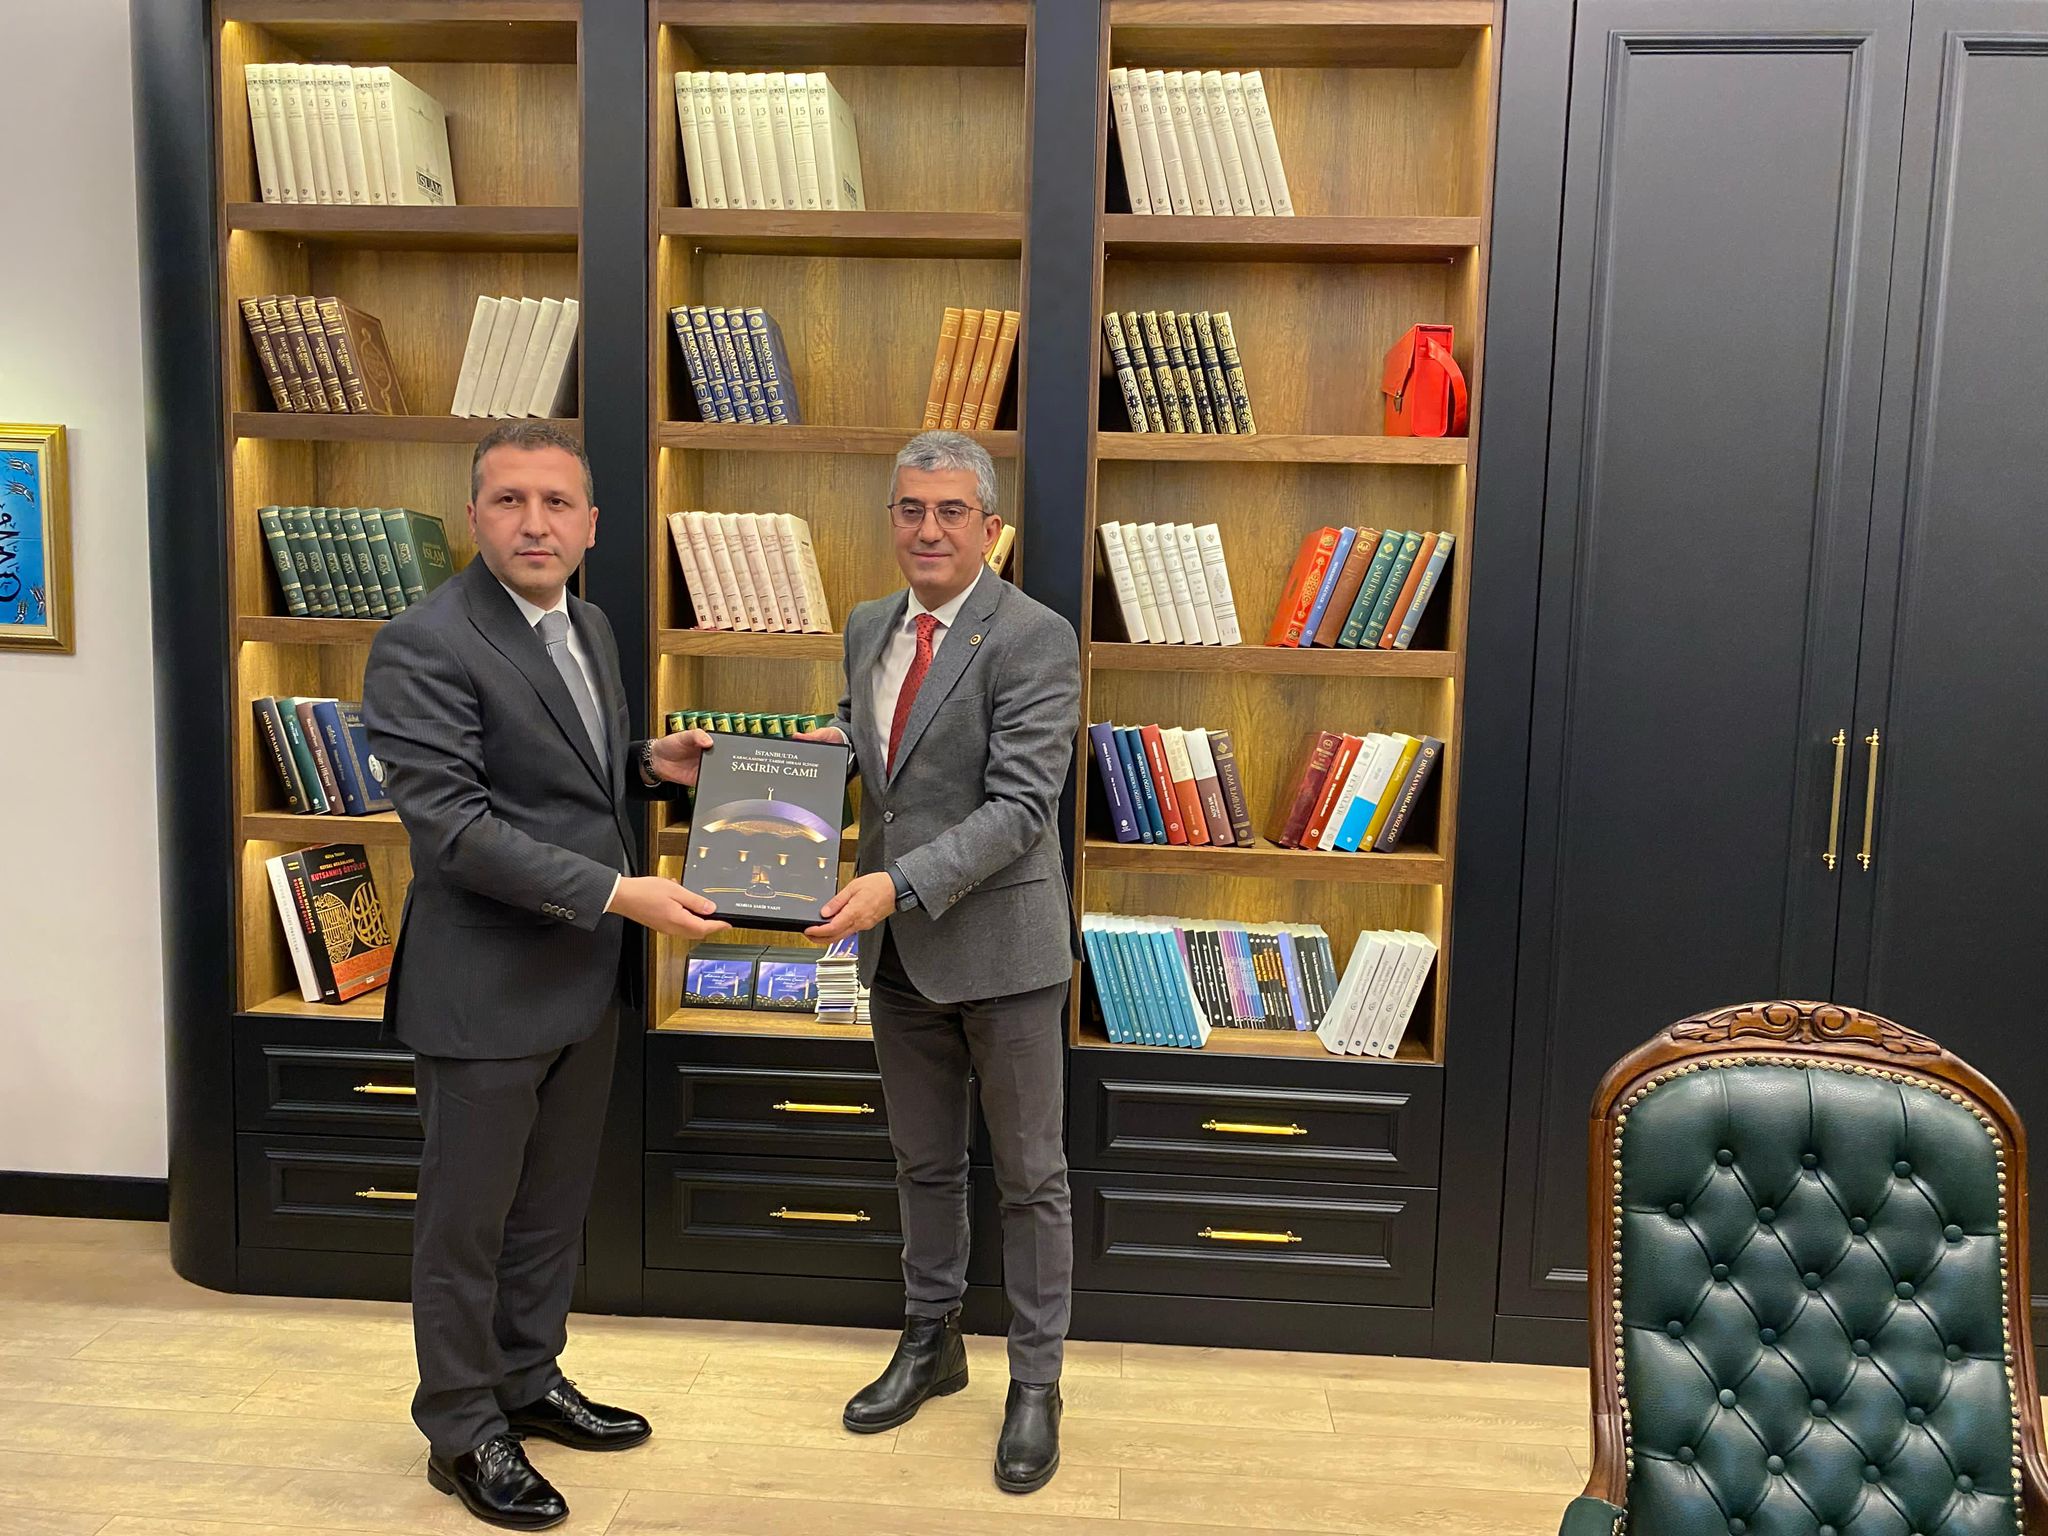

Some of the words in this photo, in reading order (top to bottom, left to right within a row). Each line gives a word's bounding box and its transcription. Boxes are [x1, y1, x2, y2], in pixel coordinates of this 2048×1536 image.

[272, 98, 278, 106] 2
[289, 97, 296, 105] 3
[380, 100, 386, 109] 8
[362, 102, 367, 110] 7
[683, 106, 689, 114] 9
[701, 106, 711, 115] 10
[719, 105, 726, 114] 11
[775, 106, 784, 115] 14
[1120, 103, 1128, 112] 17
[1140, 104, 1149, 112] 18
[1159, 105, 1167, 114] 19
[1215, 106, 1226, 115] 22
[737, 107, 745, 116] 12
[756, 107, 766, 116] 13
[795, 106, 806, 116] 15
[815, 106, 824, 116] 16
[1176, 106, 1187, 116] 20
[1195, 106, 1206, 116] 21
[1234, 107, 1245, 116] 23
[1254, 107, 1266, 116] 24
[694, 358, 705, 376] YOLU
[712, 359, 723, 377] YOLU
[731, 360, 741, 378] YOLU
[748, 361, 758, 378] YOLU
[767, 361, 776, 379] YOLU
[731, 761, 780, 774] ŞAKİRİN
[1400, 774, 1421, 813] KAVRAMLAR
